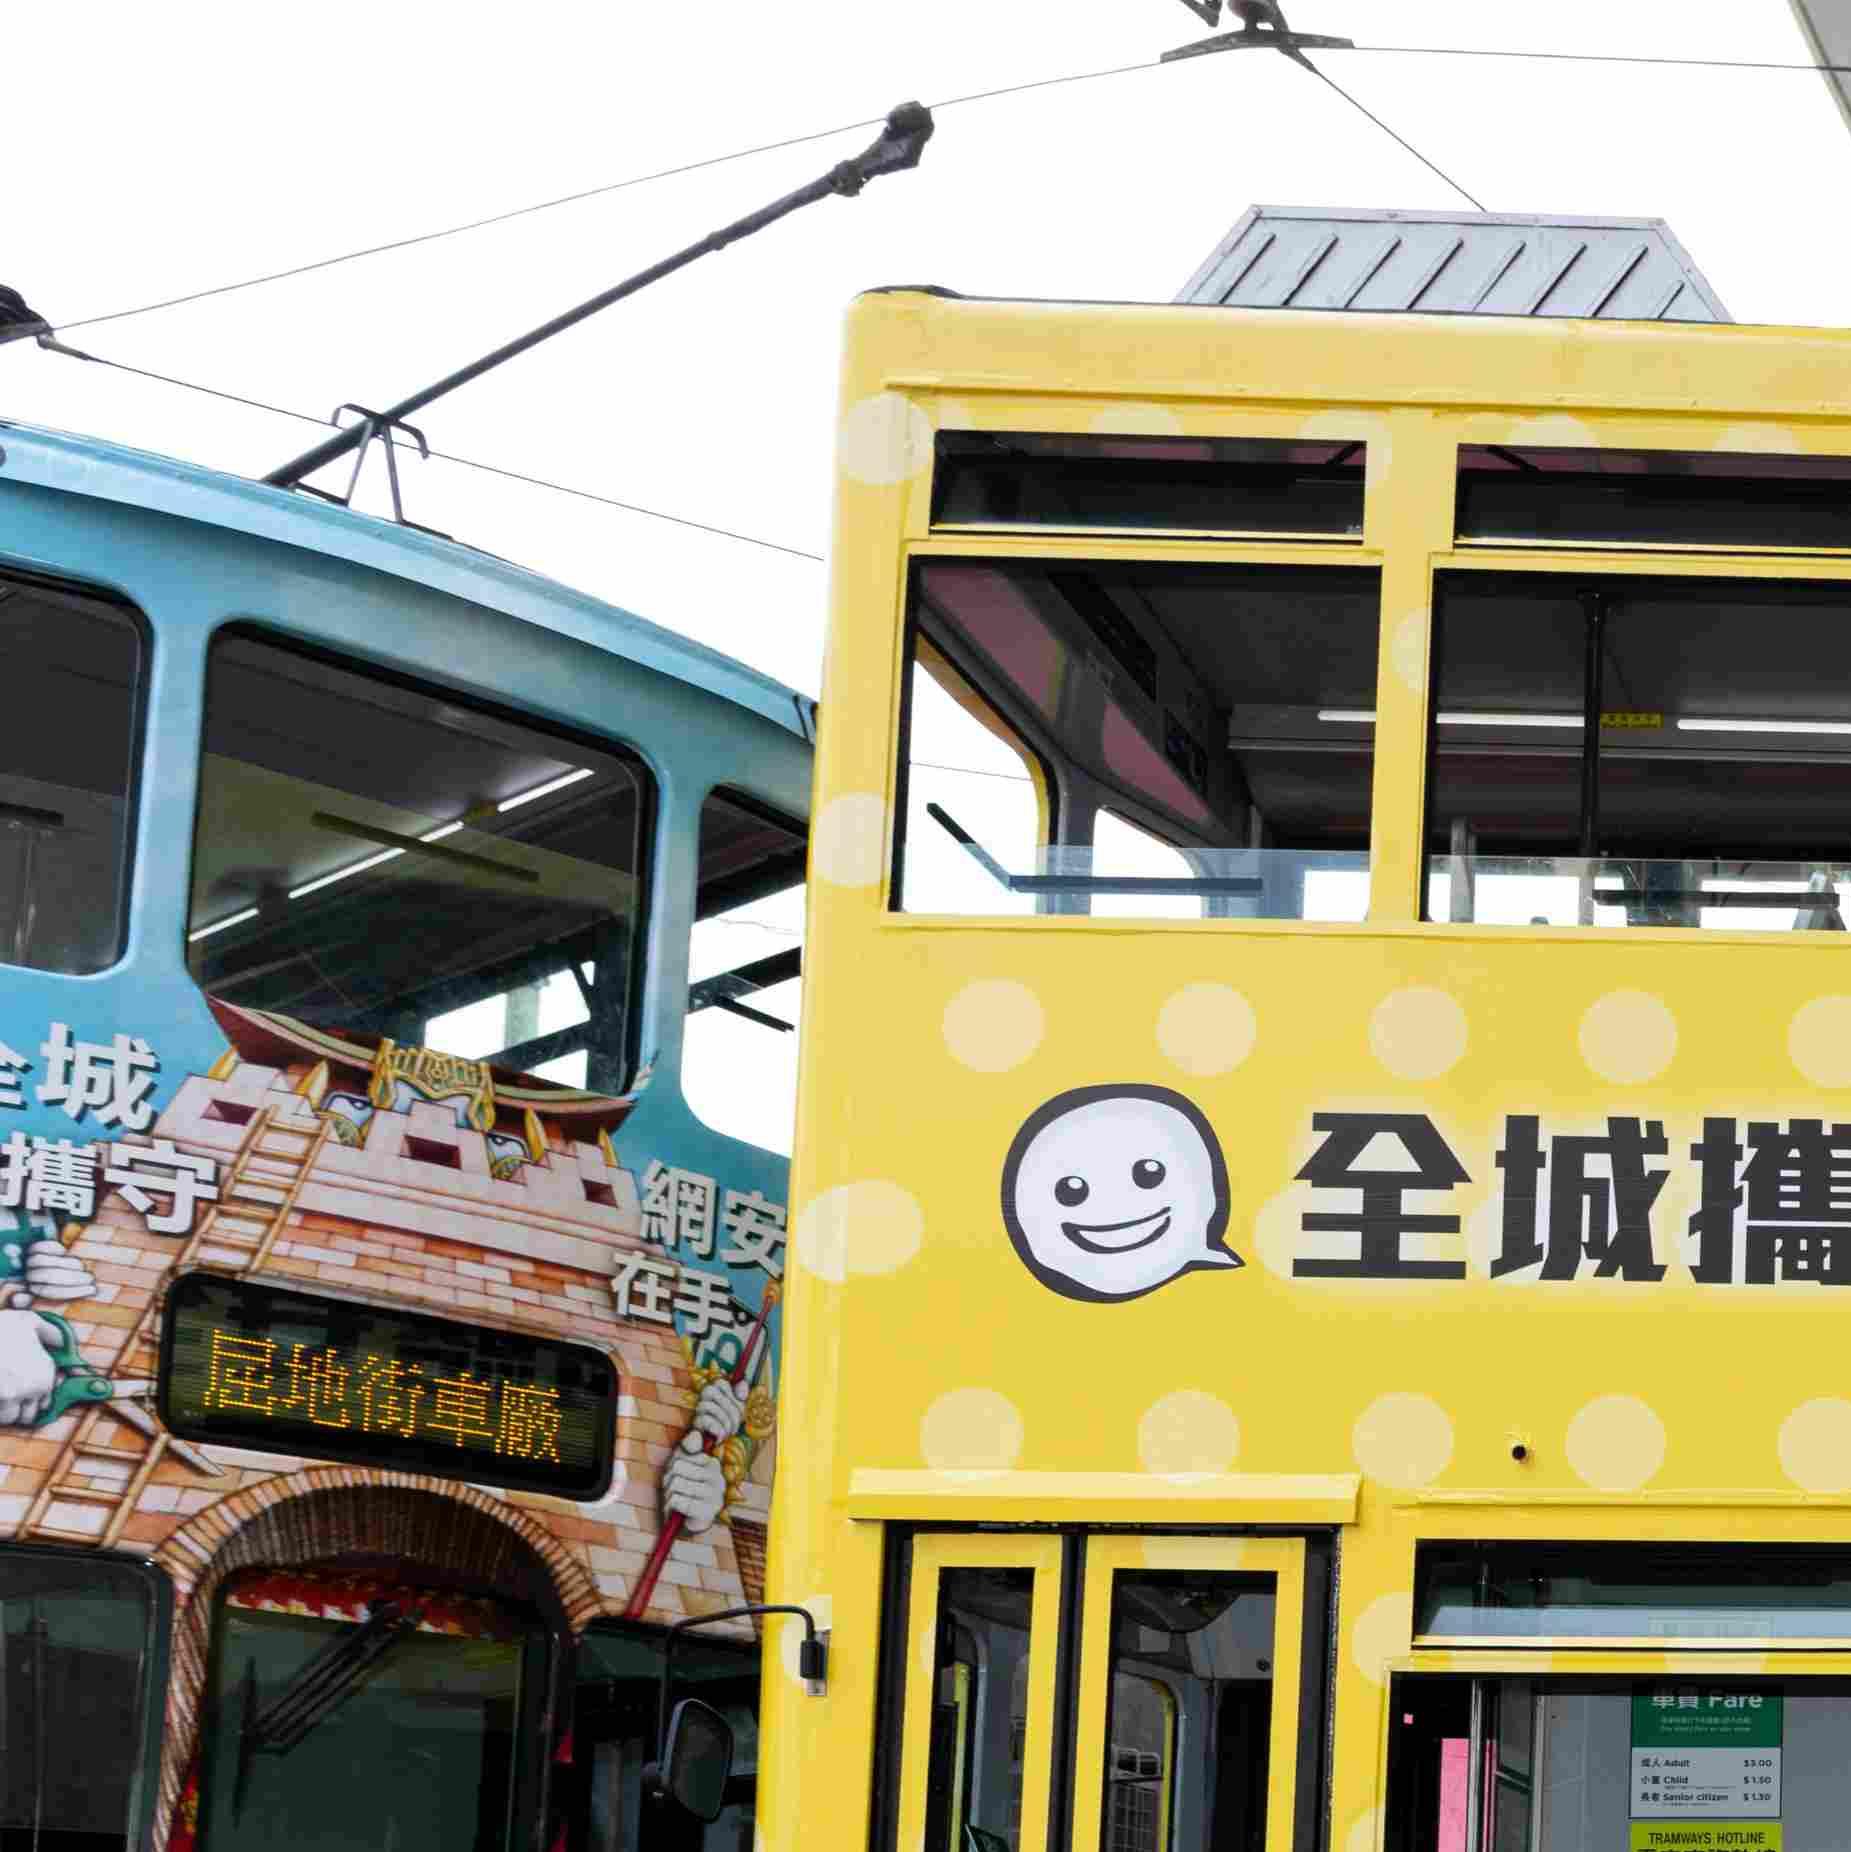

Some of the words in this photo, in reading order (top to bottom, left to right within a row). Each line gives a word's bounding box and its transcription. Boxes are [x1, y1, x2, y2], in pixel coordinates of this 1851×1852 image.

[0, 1131, 219, 1234] 攜守
[640, 1158, 787, 1277] 網安
[611, 1250, 735, 1336] 在手
[1663, 1776, 1689, 1785] Child
[1648, 1831, 1712, 1844] TRAMWAYS
[1716, 1831, 1766, 1844] HOTLINE
